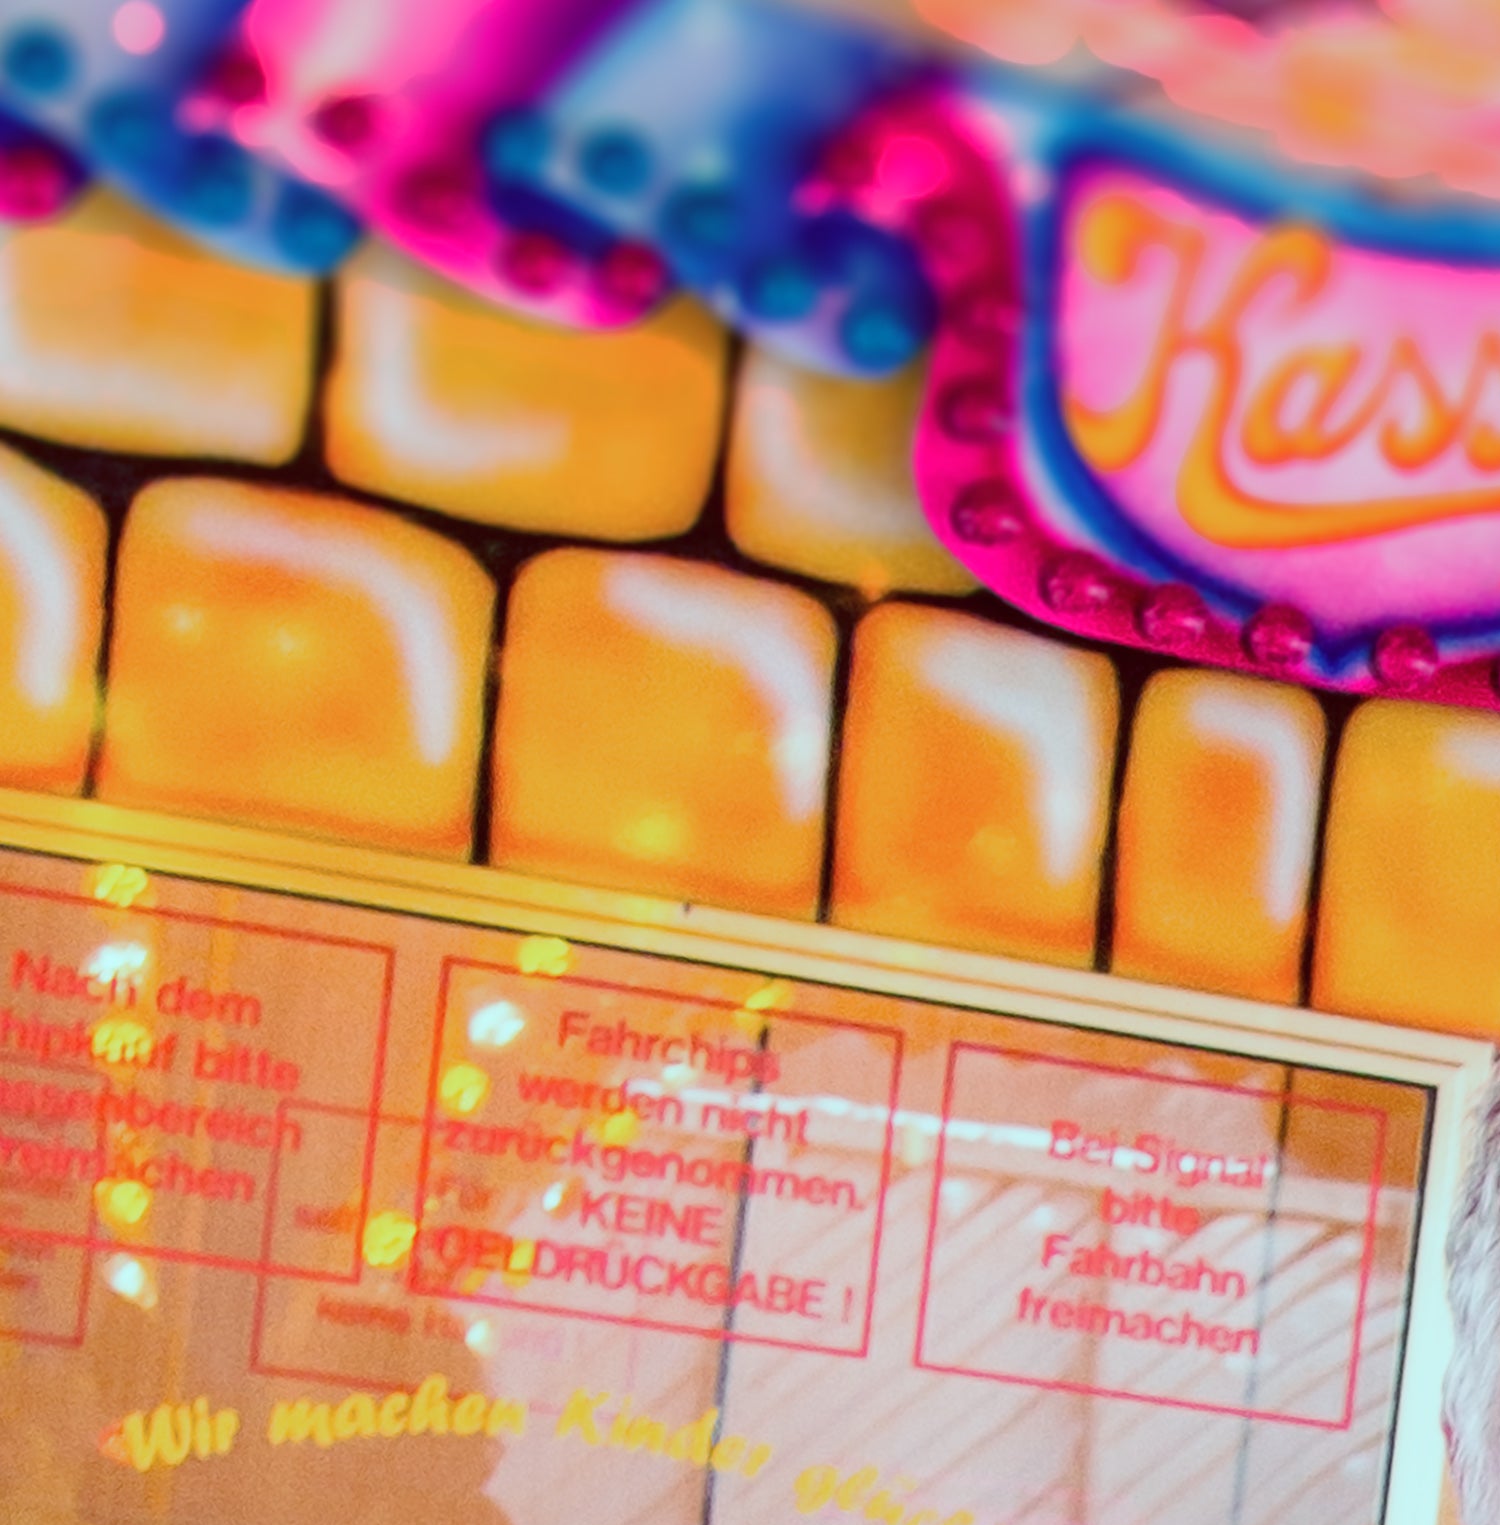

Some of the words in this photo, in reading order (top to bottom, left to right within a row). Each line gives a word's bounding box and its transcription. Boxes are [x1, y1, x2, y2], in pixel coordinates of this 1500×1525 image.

[156, 977, 262, 1027] dem
[193, 1038, 302, 1093] bitte
[557, 1010, 781, 1085] Fahrchips
[517, 1071, 685, 1128] werden
[702, 1096, 811, 1146] nicht
[1048, 1118, 1119, 1163] Bei
[1135, 1131, 1268, 1189] Signal
[579, 1189, 723, 1248] KEINE
[1101, 1185, 1201, 1237] bitte
[1040, 1232, 1247, 1299] Fahrbahn
[1016, 1285, 1261, 1357] freimachen
[122, 1395, 240, 1473] Wir
[267, 1372, 526, 1449] machen
[555, 1387, 773, 1478] Kinder
